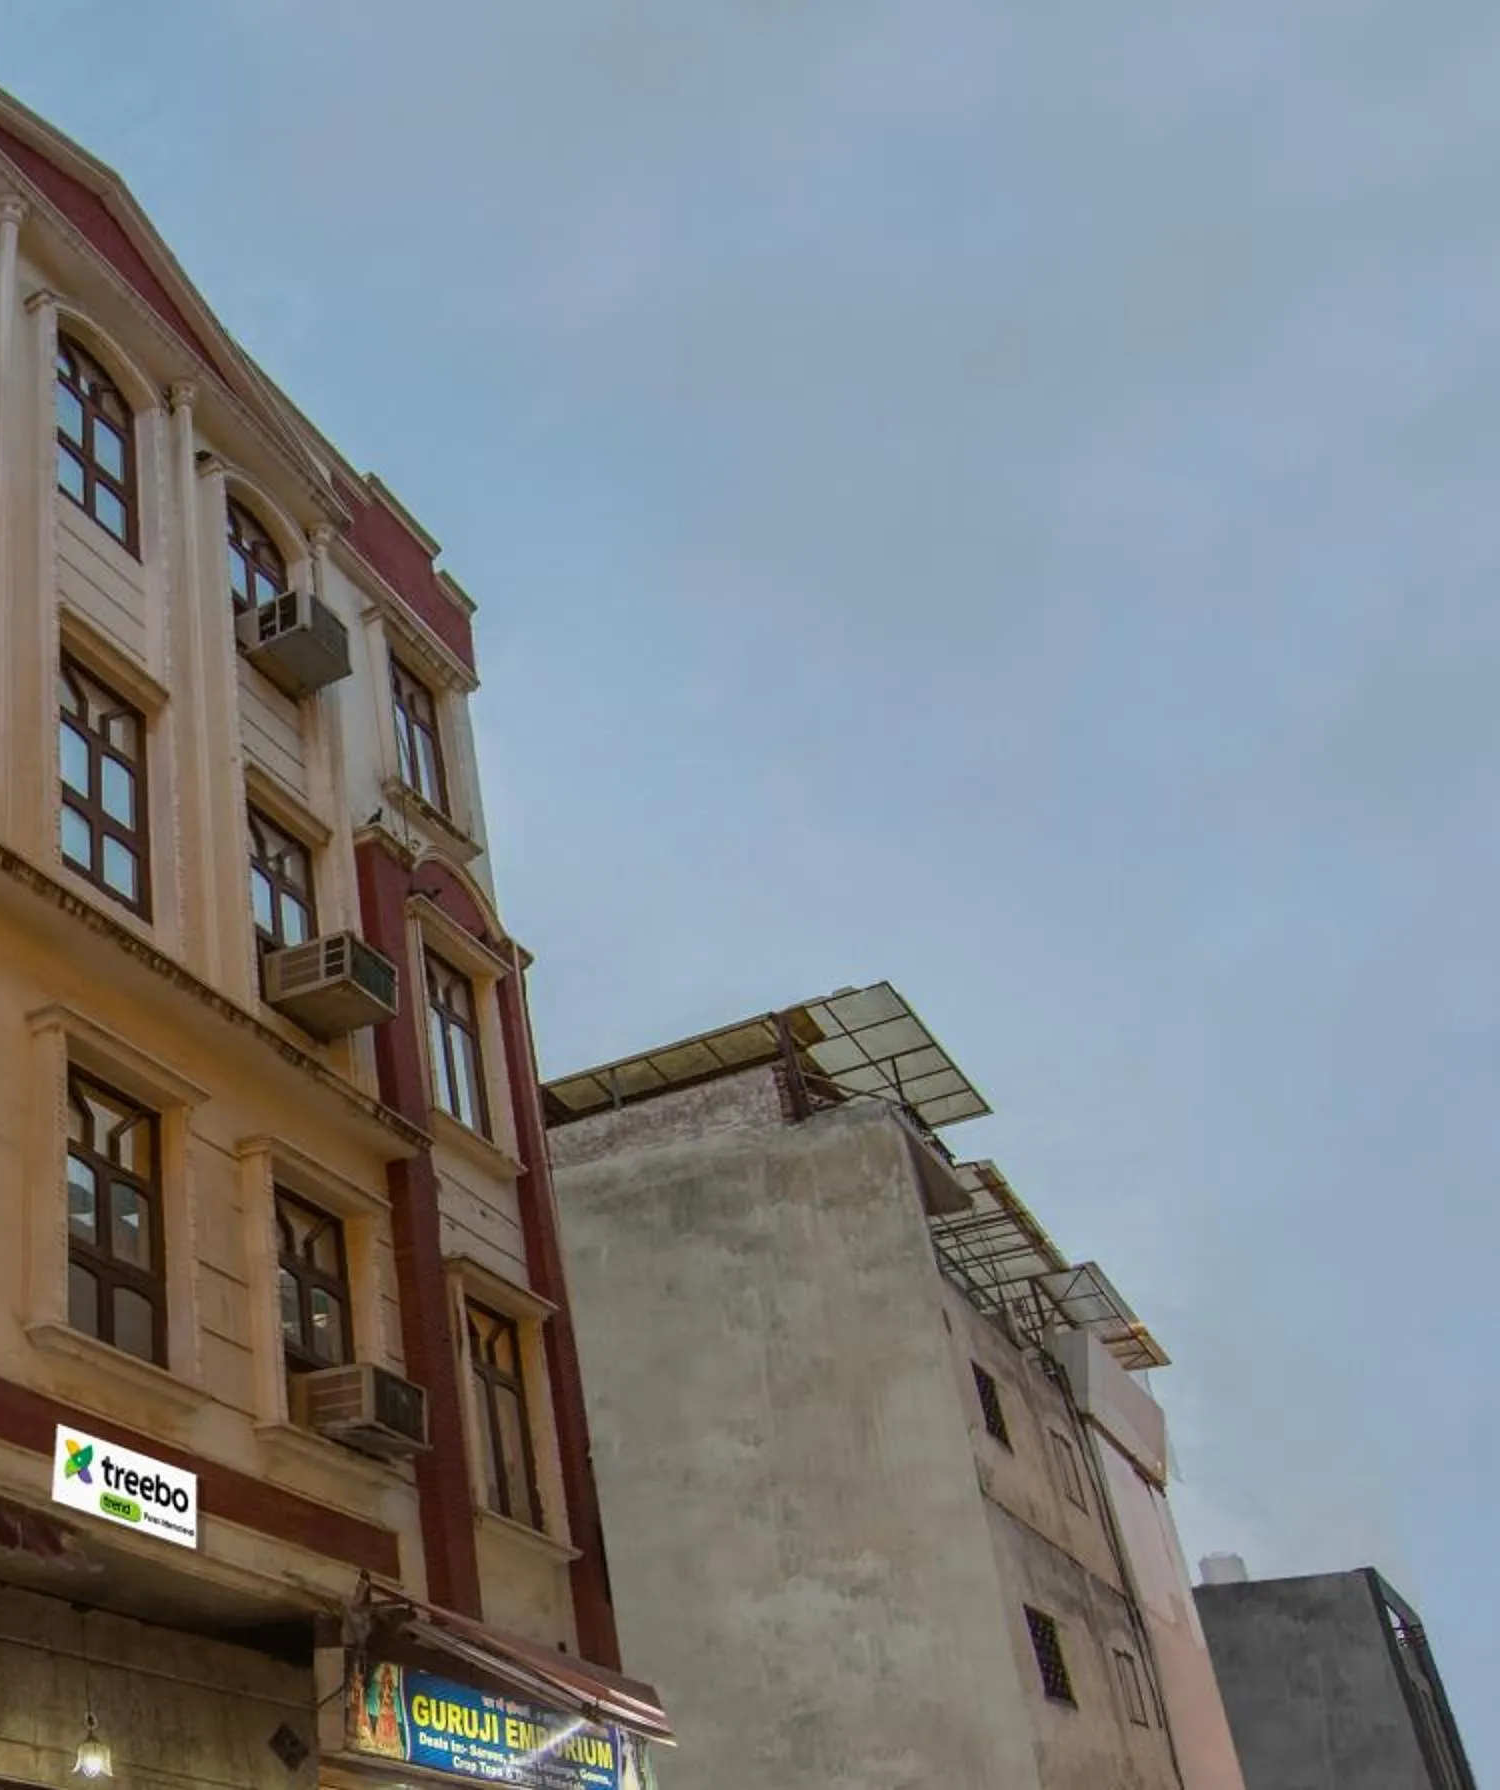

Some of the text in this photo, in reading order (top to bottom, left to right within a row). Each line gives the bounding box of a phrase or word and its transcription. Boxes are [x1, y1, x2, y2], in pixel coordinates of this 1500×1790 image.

[101, 1456, 189, 1513] treebo
[104, 1496, 131, 1515] trend
[411, 1695, 499, 1745] GURUJI
[419, 1732, 449, 1751] Deals
